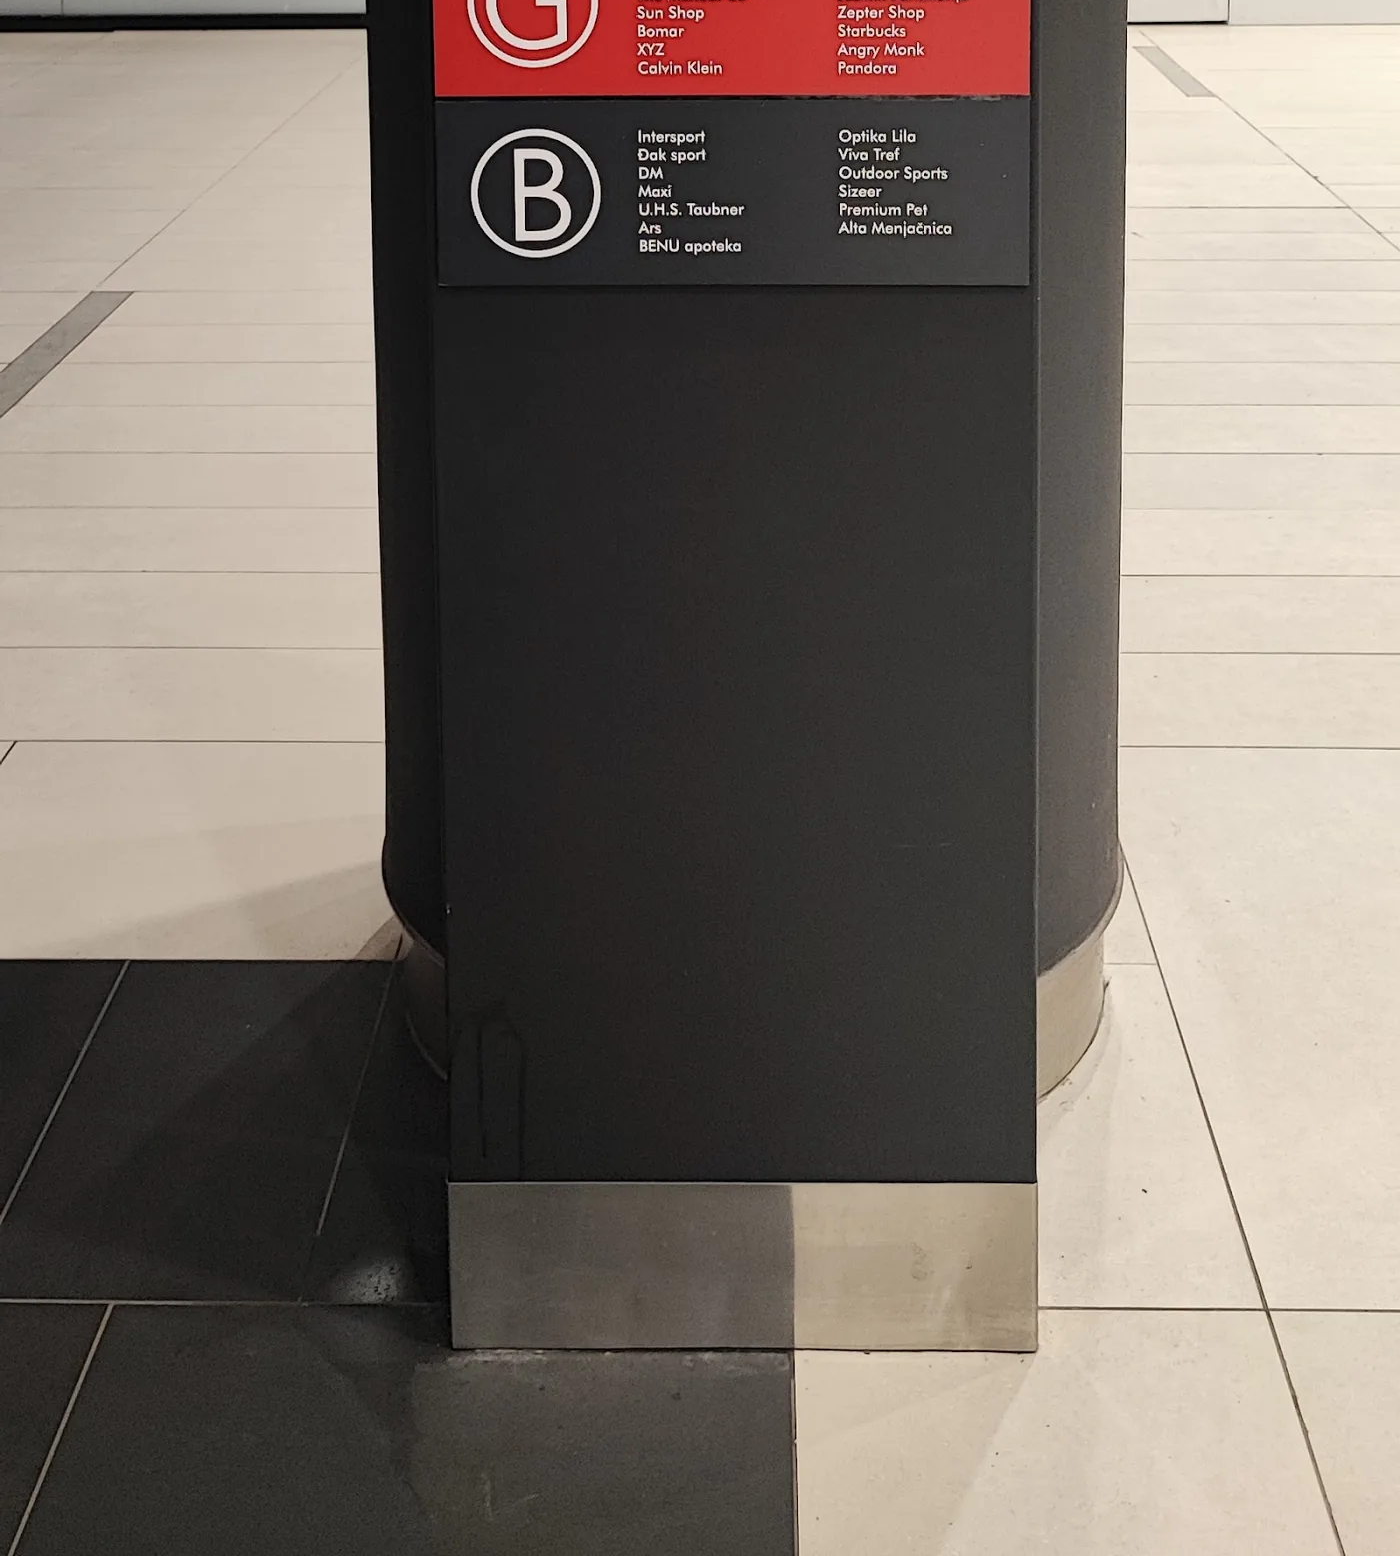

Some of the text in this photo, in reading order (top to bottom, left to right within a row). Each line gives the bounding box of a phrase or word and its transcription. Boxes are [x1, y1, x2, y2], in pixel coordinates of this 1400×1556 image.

[636, 4, 705, 22] Sun Shop
[837, 4, 925, 22] Zepter Shop
[637, 24, 685, 38] Bomar
[838, 23, 906, 38] Starbucks
[636, 42, 665, 56] XYZ
[837, 41, 925, 59] Angry Monk
[637, 60, 723, 75] Calvin Klein
[838, 61, 897, 75] Pandora
[637, 129, 706, 147] Intersport
[838, 128, 916, 146] Optika Lila
[637, 147, 707, 165] Đak sport
[837, 147, 900, 162] Viva Tref
[638, 166, 664, 180] DM
[838, 165, 949, 184] Outdoor Sports
[513, 148, 572, 242] B
[637, 184, 673, 198] Maxi
[838, 184, 883, 198] Sizeer
[638, 201, 745, 217] U.H.S. Taubner
[839, 202, 928, 217] Premium Pet
[638, 220, 662, 235] Ars
[838, 219, 952, 239] Alta Menjačnica
[639, 237, 742, 256] BENU apoteka
